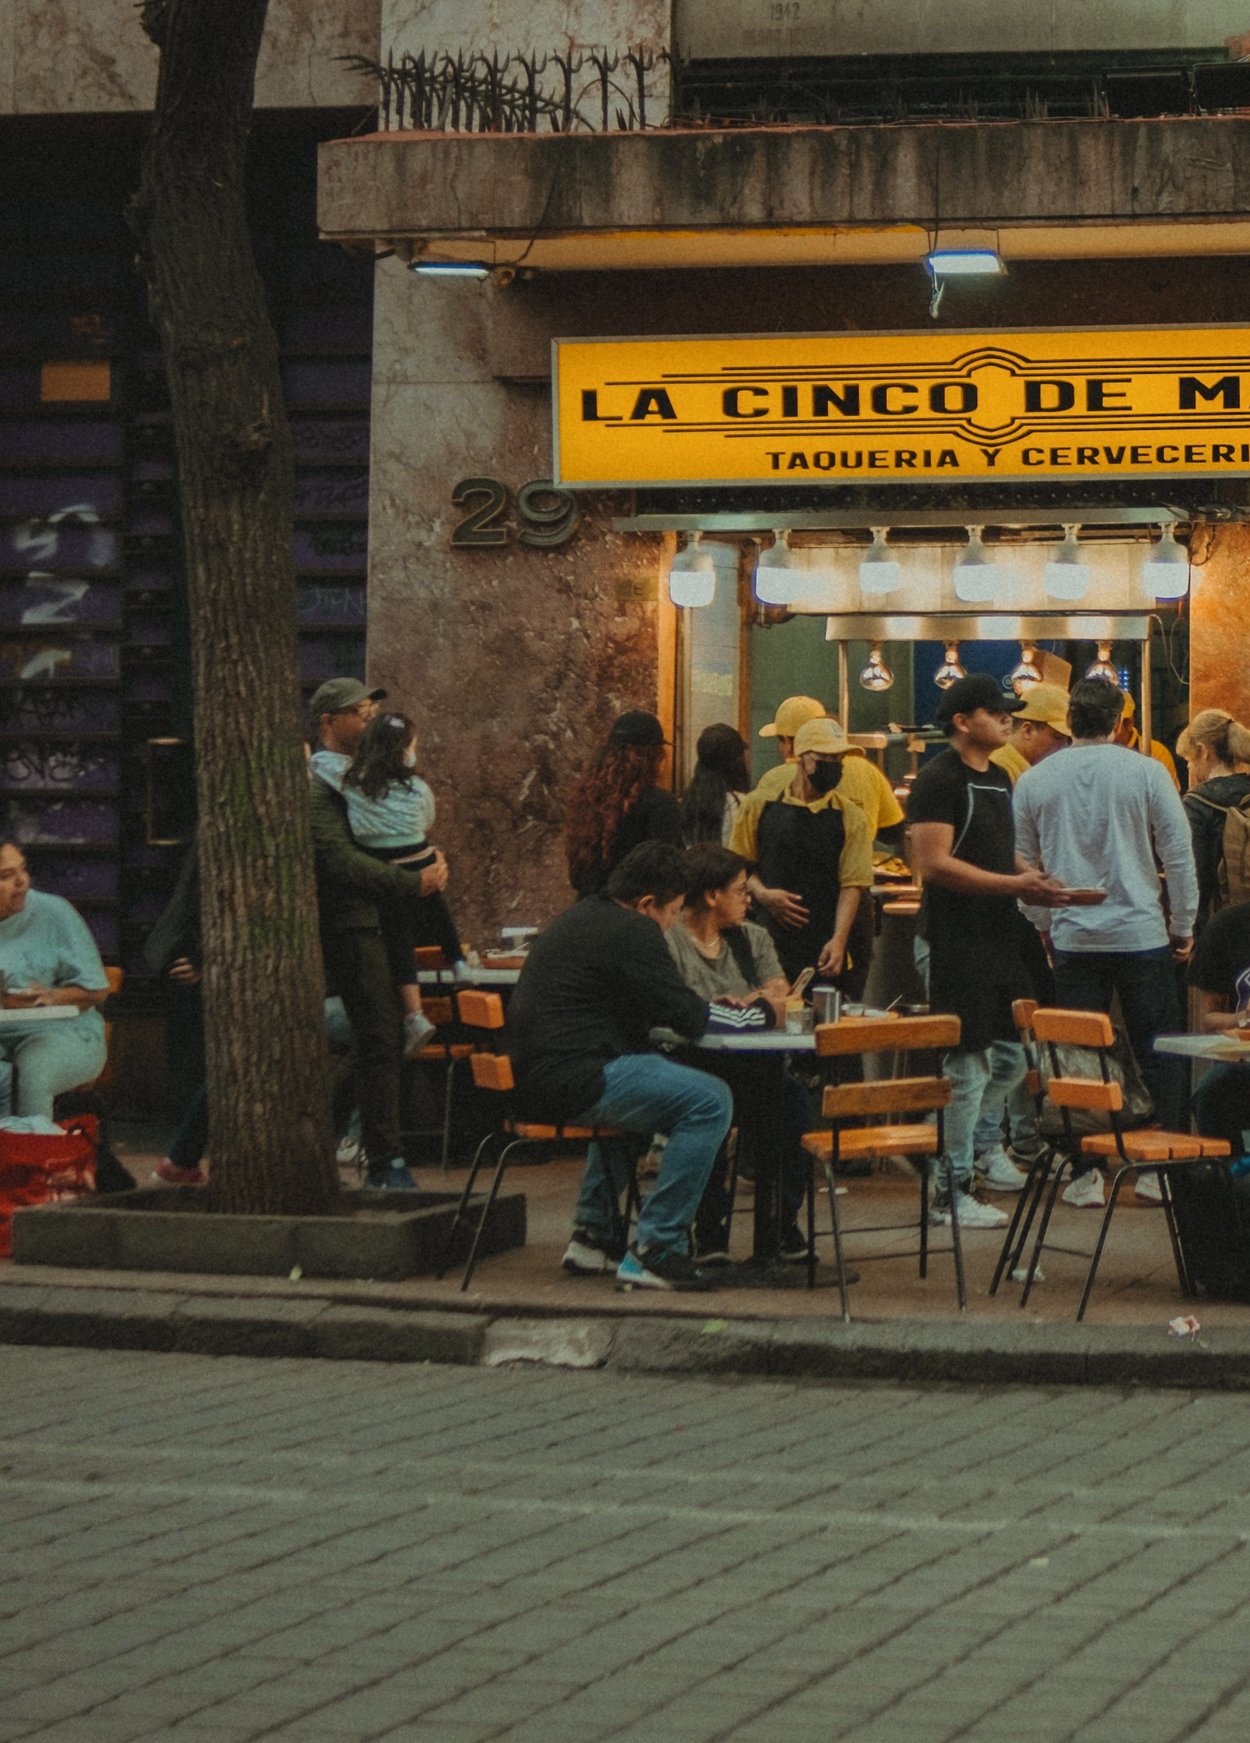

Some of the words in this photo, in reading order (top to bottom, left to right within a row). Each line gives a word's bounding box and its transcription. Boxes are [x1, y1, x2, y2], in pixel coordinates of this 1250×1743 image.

[581, 387, 678, 422] LA
[722, 382, 979, 419] CINCO
[1024, 377, 1133, 413] DE
[765, 449, 960, 471] TAQUERIA
[980, 448, 1003, 467] Y
[450, 477, 578, 547] 29
